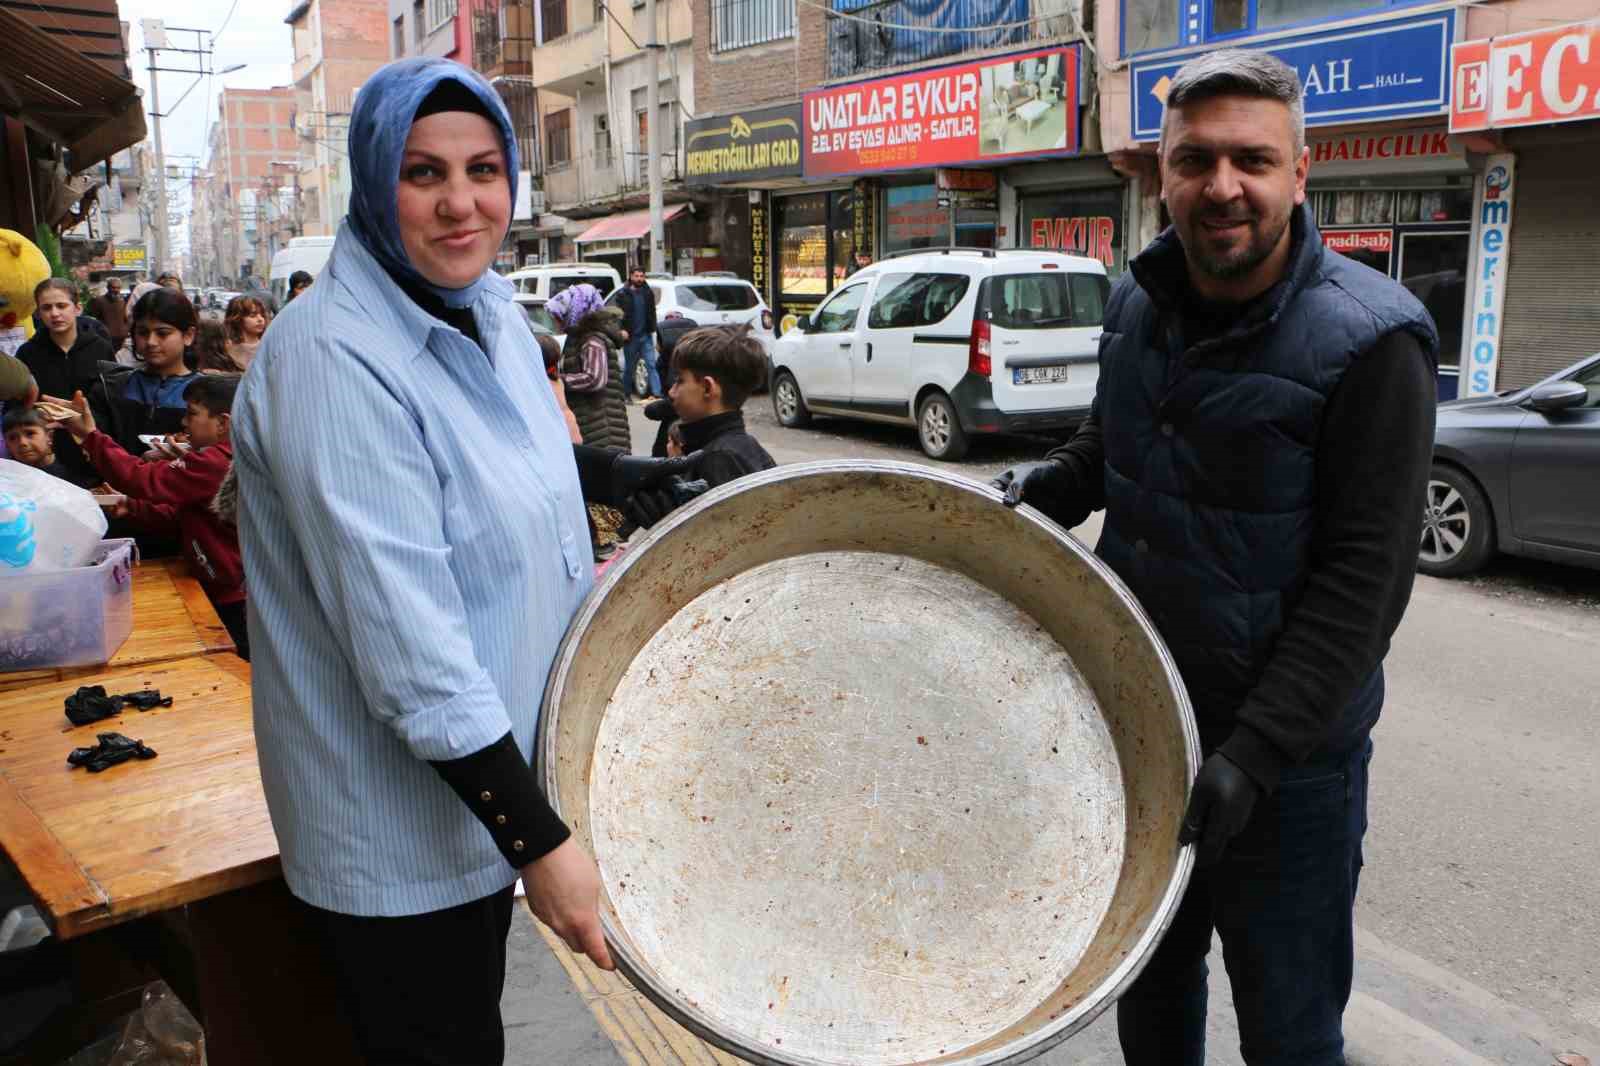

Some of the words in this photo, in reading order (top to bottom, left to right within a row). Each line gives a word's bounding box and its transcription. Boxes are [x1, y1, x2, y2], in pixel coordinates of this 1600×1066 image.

[1290, 58, 1352, 97] AH
[1491, 33, 1600, 119] EC
[810, 86, 896, 132] UNATLAR
[902, 73, 977, 120] EVKUR
[771, 138, 799, 167] GOLD
[1314, 132, 1449, 162] HALICILIK
[1031, 216, 1115, 267] EVKUR
[1472, 200, 1508, 393] merinos
